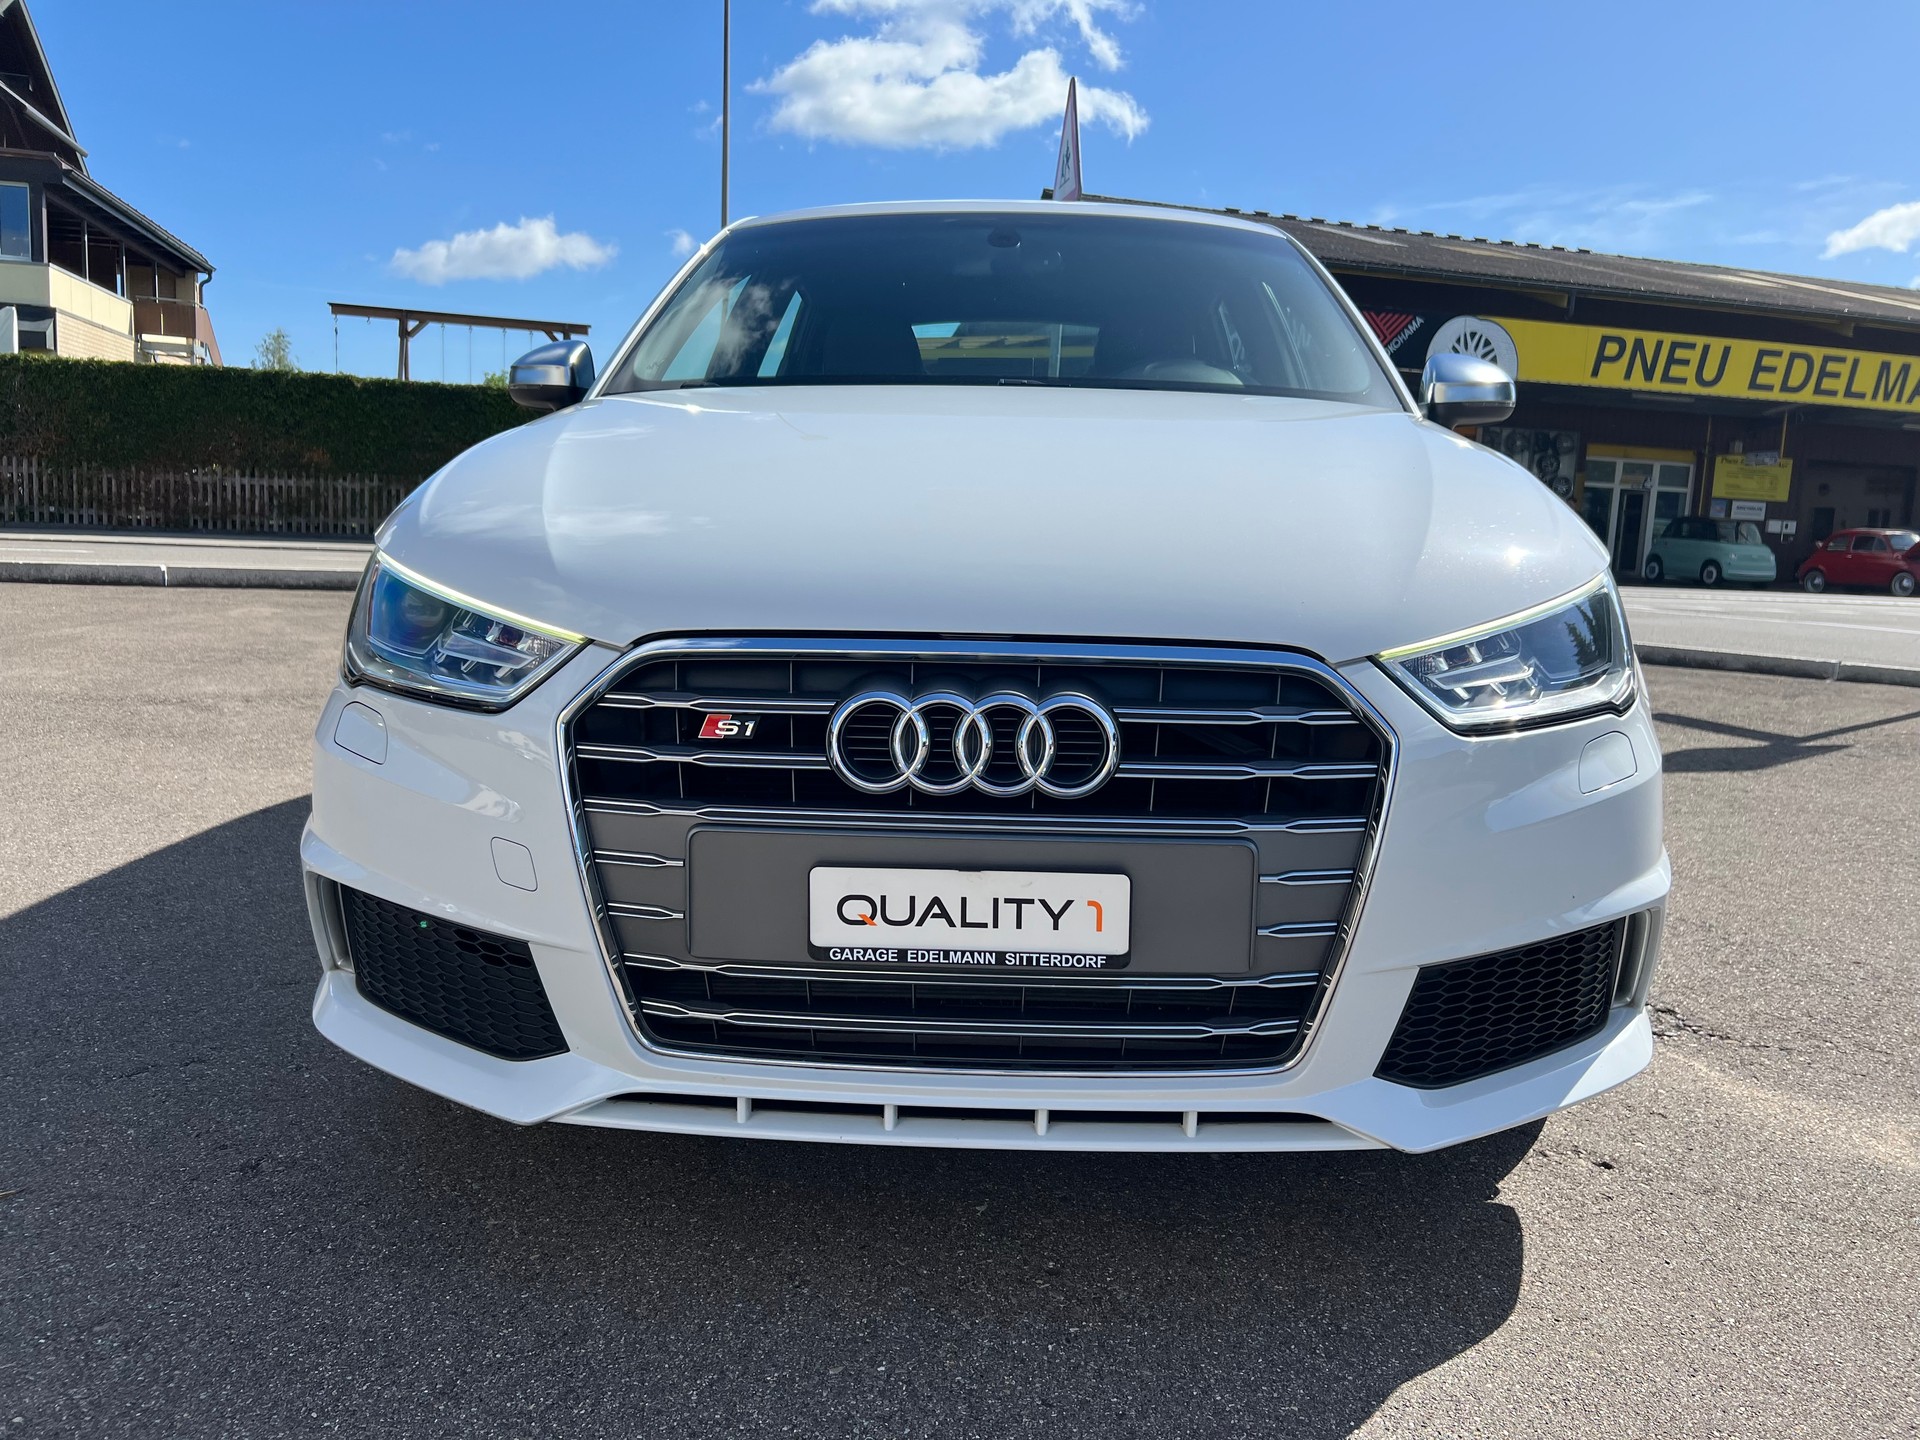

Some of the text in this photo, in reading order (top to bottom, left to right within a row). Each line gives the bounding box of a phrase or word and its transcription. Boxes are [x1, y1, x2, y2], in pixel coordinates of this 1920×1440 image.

[1385, 315, 1425, 357] KOHAMA
[1590, 335, 1732, 388] PNEU
[714, 719, 756, 737] S1
[829, 947, 1107, 969] GARAGE EDELMANN SITTERDORF
